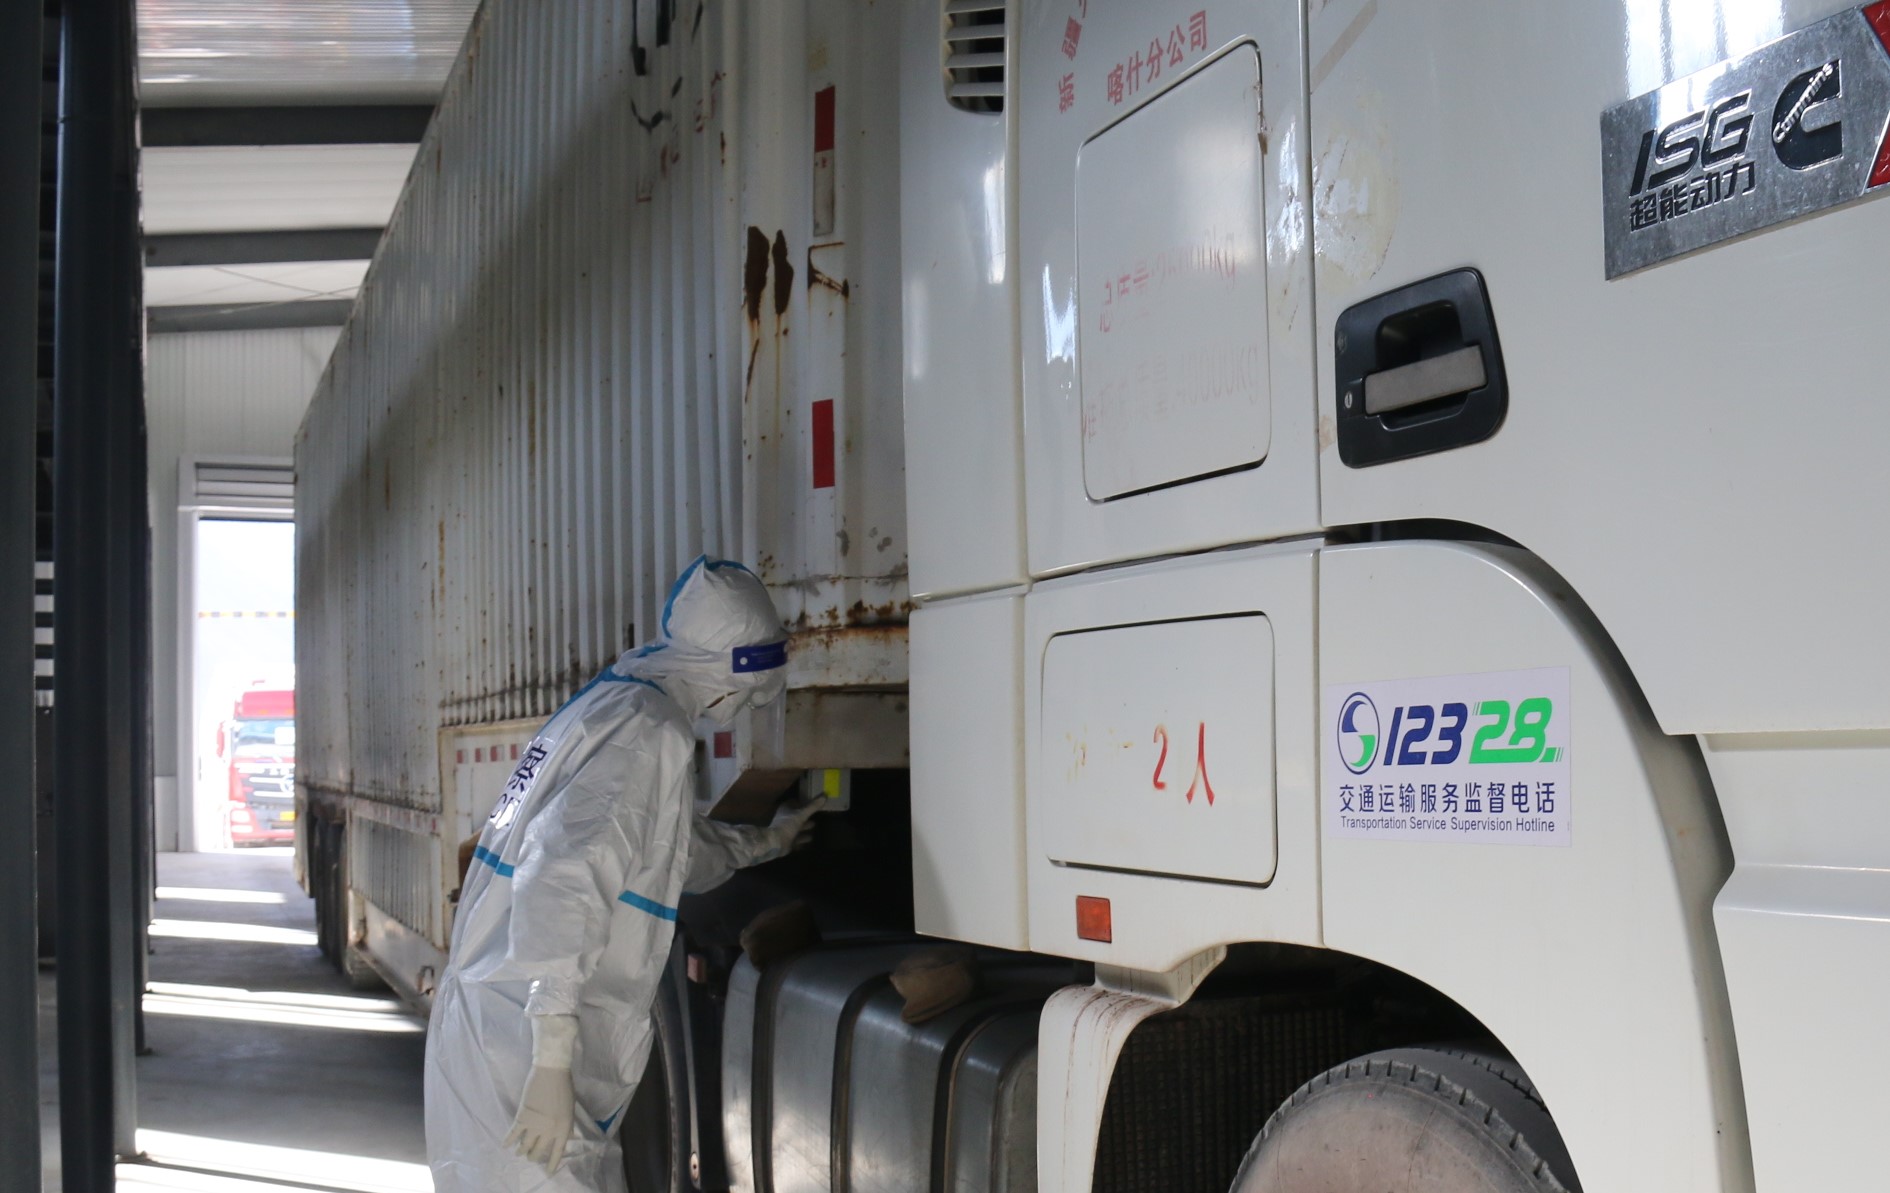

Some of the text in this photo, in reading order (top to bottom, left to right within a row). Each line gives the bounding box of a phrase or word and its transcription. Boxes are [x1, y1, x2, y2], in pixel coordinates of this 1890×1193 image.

[1107, 10, 1208, 106] 喀什分公司
[1629, 89, 1754, 198] ISG
[1630, 161, 1756, 232] 超能动力
[1383, 697, 1555, 766] 12328
[1339, 781, 1555, 814] 交通运输服务监督电话
[1341, 815, 1555, 833] Transportation Service Supervision Hotline
